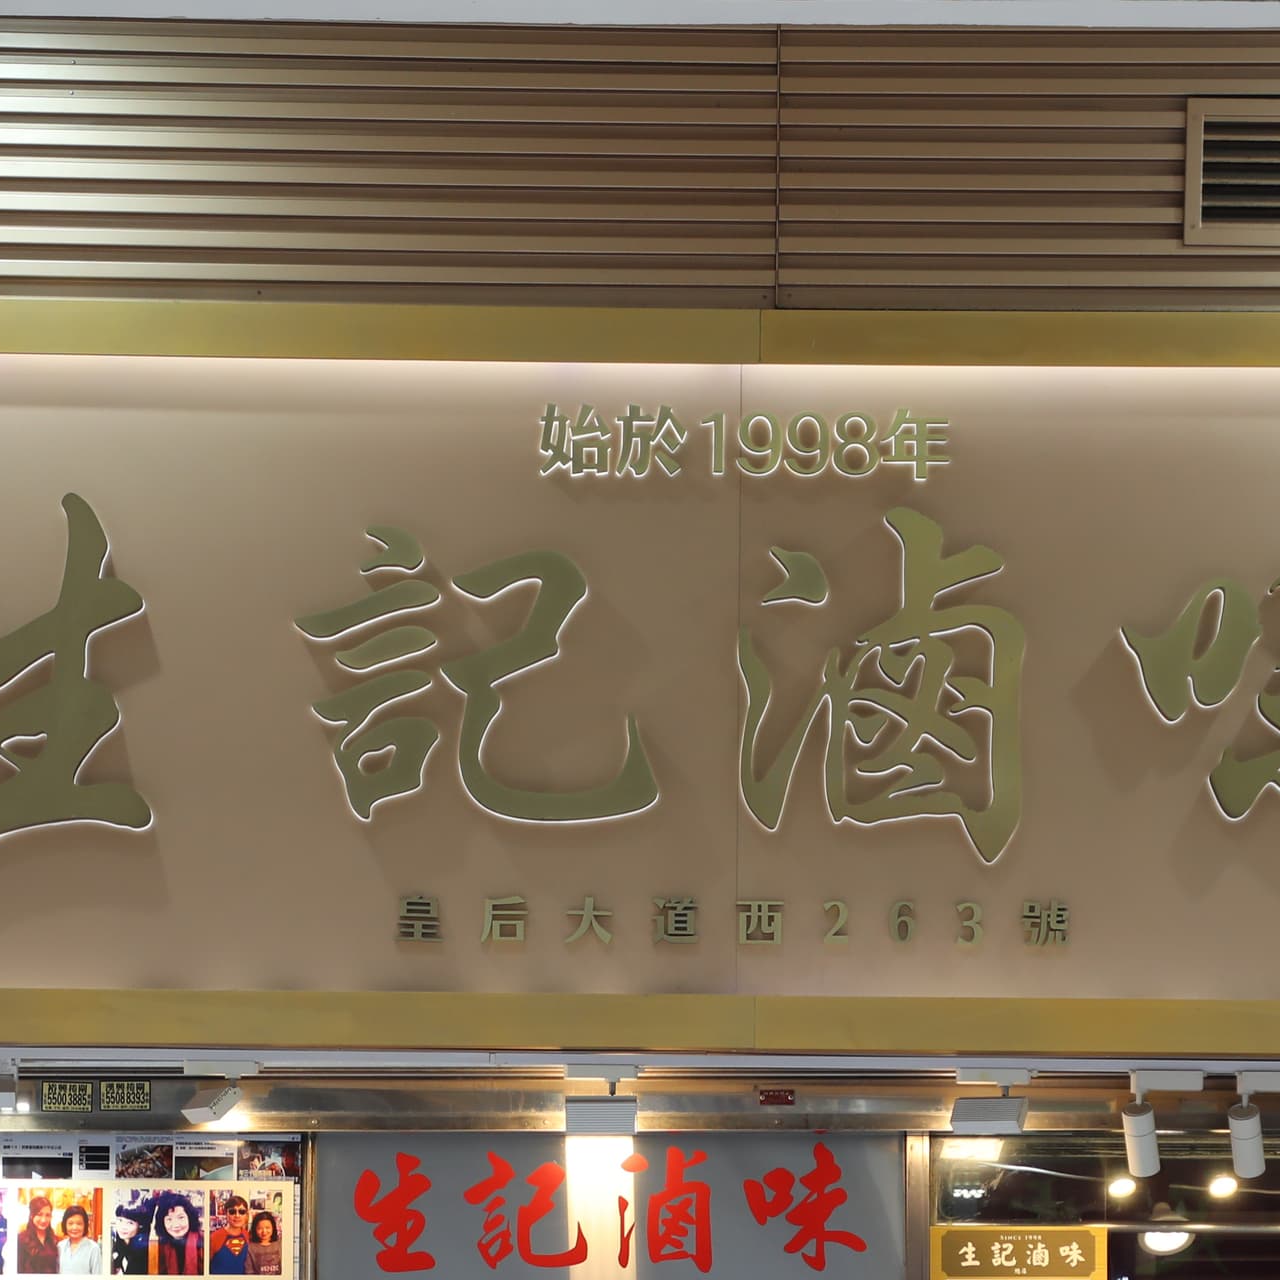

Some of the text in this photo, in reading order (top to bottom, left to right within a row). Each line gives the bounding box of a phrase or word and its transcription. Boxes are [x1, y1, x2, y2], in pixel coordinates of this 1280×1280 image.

[538, 404, 950, 479] 始於1998年
[395, 895, 1072, 947] 皇后大道西263號
[353, 1142, 868, 1273] 生記滷味
[958, 1242, 1086, 1267] 生記滷味
